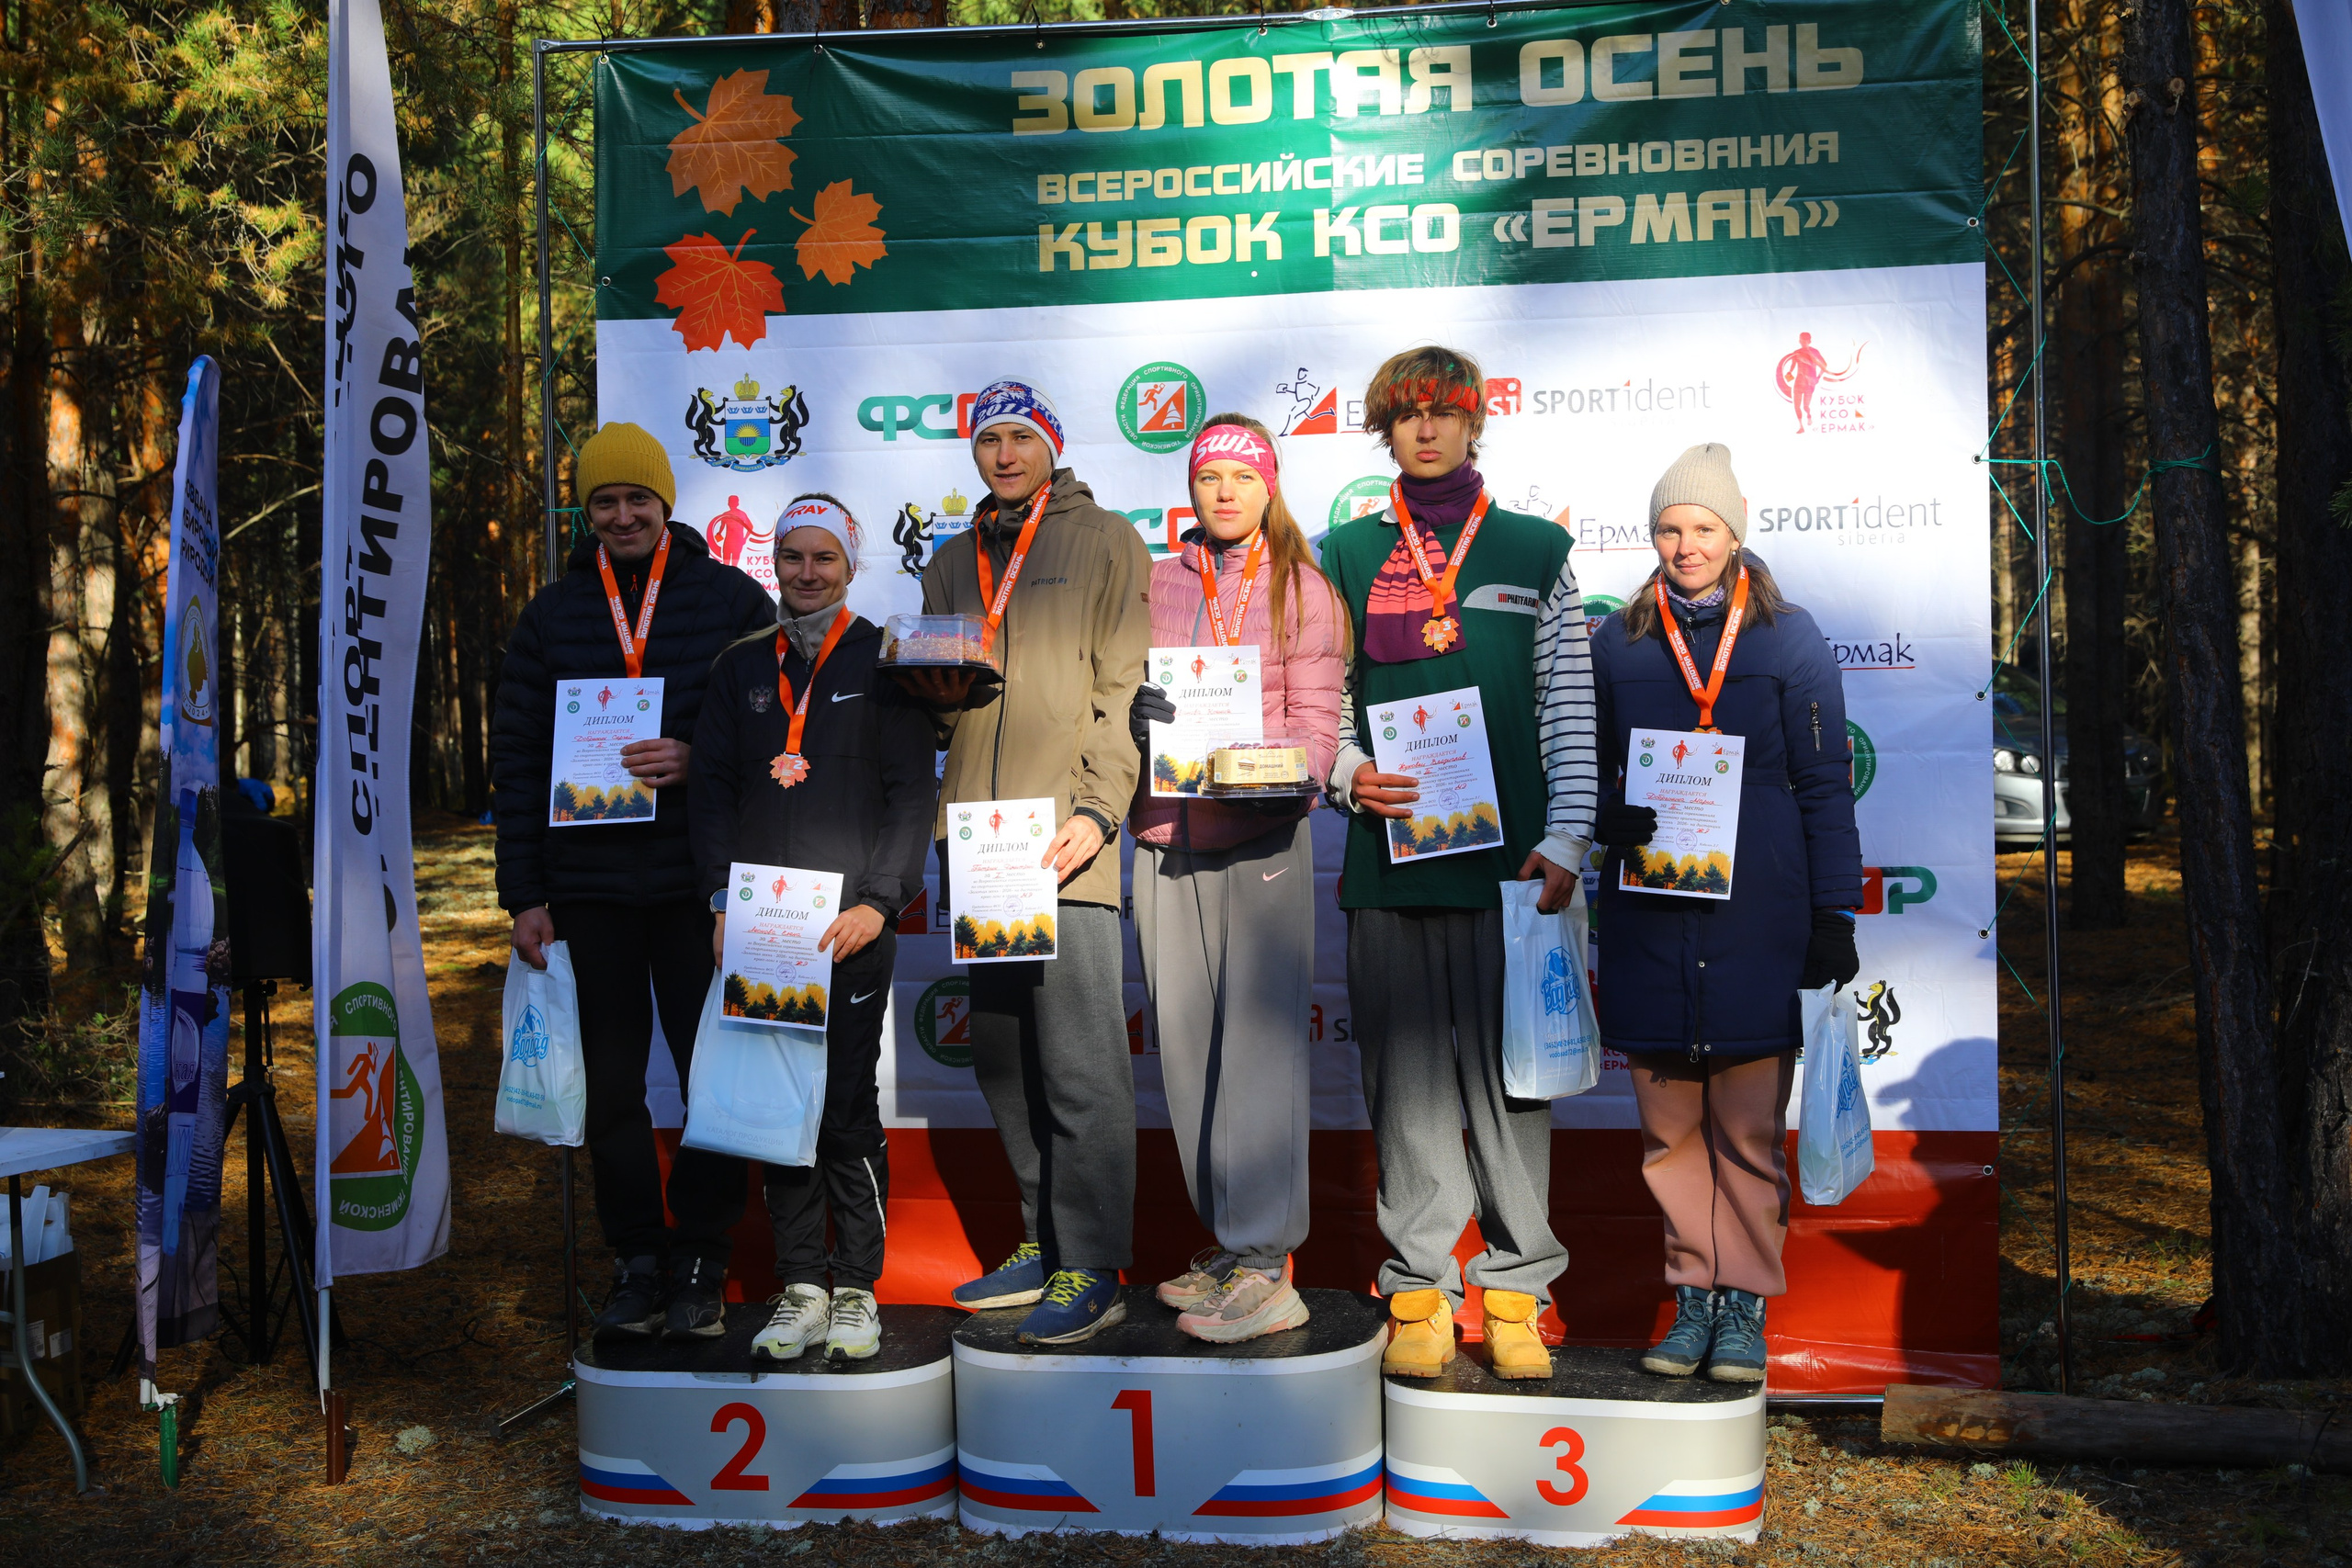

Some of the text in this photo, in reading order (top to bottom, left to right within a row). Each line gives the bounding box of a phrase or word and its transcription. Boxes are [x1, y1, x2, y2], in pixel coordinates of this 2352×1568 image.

[1011, 23, 1863, 136] ЗОЛОТАЯ ОСЕНЬ
[1037, 131, 1838, 204] ВСЕРОССИЙСКИЕ СОРЕВНОВАНИЯ
[1039, 186, 1839, 272] КУБОК КСО «ЕРМАК»
[1120, 366, 1203, 449] ФЕДЕРАЦИЯ СПОРТИВНОГО ОРИЕНТИРОВАНИЯ ТЮМЕНСКОЙ ОБЛАСТИ
[1532, 378, 1711, 415] SPORTident
[1820, 394, 1864, 405] КУБОК
[1820, 409, 1849, 419] КСО
[184, 478, 213, 531] ОЗДАНА
[1332, 479, 1391, 525] ФЕДЕРАЦИЯ СПОРТИВН
[1392, 480, 1401, 504] ТЮМЕ
[1028, 493, 1046, 525] ТЮМЕНЬ
[1758, 494, 1943, 533] SPORTident
[182, 506, 219, 567] БИРСКОЙ
[659, 527, 670, 551] ТЮМЕ
[1252, 533, 1263, 552] ТЮМЕ
[1408, 523, 1420, 547] ОСЕНЬ
[1453, 515, 1482, 567] ЗОЛОТАЯ ОСЕНЬ
[1579, 518, 1653, 553] Ерм
[1838, 531, 1905, 546] siberia
[180, 536, 216, 592] РИРОДОЙ
[747, 556, 775, 566] КУБ
[747, 568, 774, 579] КСО
[1416, 545, 1434, 580] ЗОЛОТАЯ
[995, 554, 1024, 616] ЗОЛОТАЯ ОСЕНЬ
[1656, 575, 1666, 606] ТЮМЕ
[614, 595, 625, 620] ОСЕНЬ
[639, 580, 661, 639] ЗОЛОТАЯ ОСЕНЬ
[1212, 596, 1222, 619] ОСЕНЬ
[1232, 579, 1253, 638] ЗОЛОТАЯ ОСЕНЬ
[1581, 598, 1623, 609] ПОРТИВНО
[620, 621, 635, 654] ЗОЛОТАЯ
[1216, 620, 1229, 647] ОЛОТАЯ
[1442, 620, 1452, 632] 3
[1717, 608, 1743, 672] ЗОЛОТАЯ ОСЕНЬ
[1673, 629, 1702, 690] ЗОЛОТАЯ ОСЕНЬ
[1824, 631, 1916, 666] рмак
[1178, 687, 1234, 700] ДИПЛОМ
[582, 715, 635, 727] ДИПЛОМ
[1404, 733, 1458, 753] ДИПЛОМ
[1411, 749, 1457, 761] НАГРАЖДАЕТСЯ
[793, 760, 804, 770] 2
[1655, 773, 1713, 787] ДИПЛОМ
[1853, 737, 1872, 797] ОРИЕНТИРОВАНИЯ
[1659, 788, 1707, 797] НАГРАЖДАЕТСЯ
[977, 841, 1029, 855] ДИПЛОМ
[754, 907, 809, 920] ДИПЛОМ
[759, 921, 804, 931] НАГРАЖДАЕТСЯ
[345, 994, 398, 1032] СПОРТИВНОГО
[918, 980, 969, 1022] ФЕДЕРАЦИЯ СПОРТИВ
[919, 1026, 974, 1065] МЕНСКОЙ ОБЛАСТИ
[710, 1402, 769, 1491] 2
[1110, 1390, 1156, 1497] 1
[1535, 1427, 1589, 1506] 3
